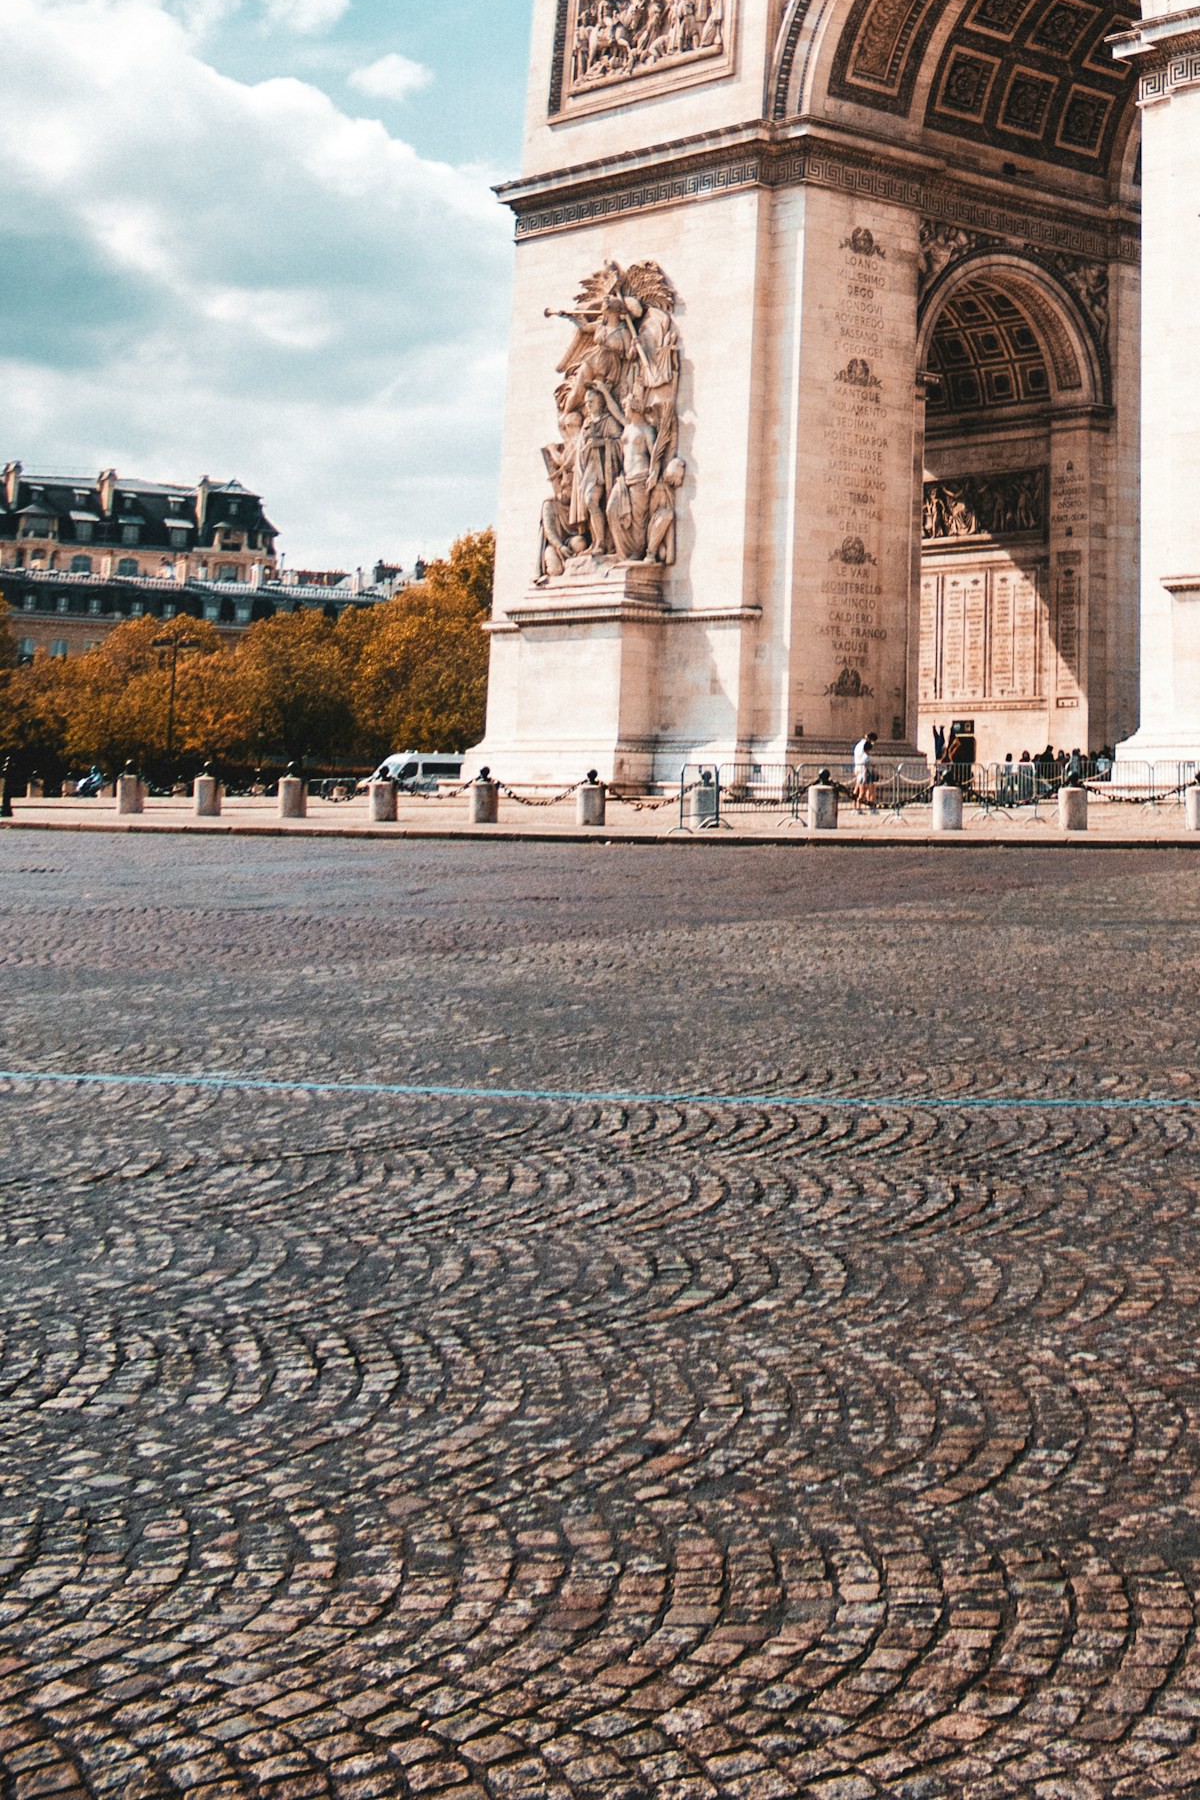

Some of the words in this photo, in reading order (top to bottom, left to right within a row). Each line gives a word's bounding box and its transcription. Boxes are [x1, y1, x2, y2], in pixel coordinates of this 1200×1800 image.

[845, 255, 879, 271] LOANO
[838, 269, 886, 287] MILLESIMO
[847, 284, 875, 299] DEGO
[834, 311, 885, 330] ROVEREDO
[840, 326, 879, 343] BASSANO
[842, 342, 884, 359] GEORGES
[834, 387, 881, 404] MANTOUE
[837, 416, 878, 431] SEDIMAN
[854, 434, 889, 449] THABOR
[837, 566, 847, 577] LE
[850, 567, 870, 579] VAR
[821, 580, 882, 596] MONTEBELLO
[827, 596, 838, 606] LE
[840, 597, 876, 610] MINCIO
[829, 611, 874, 624] CALDIERO
[850, 627, 888, 641] FRANCO
[832, 640, 870, 654] RAGUSE
